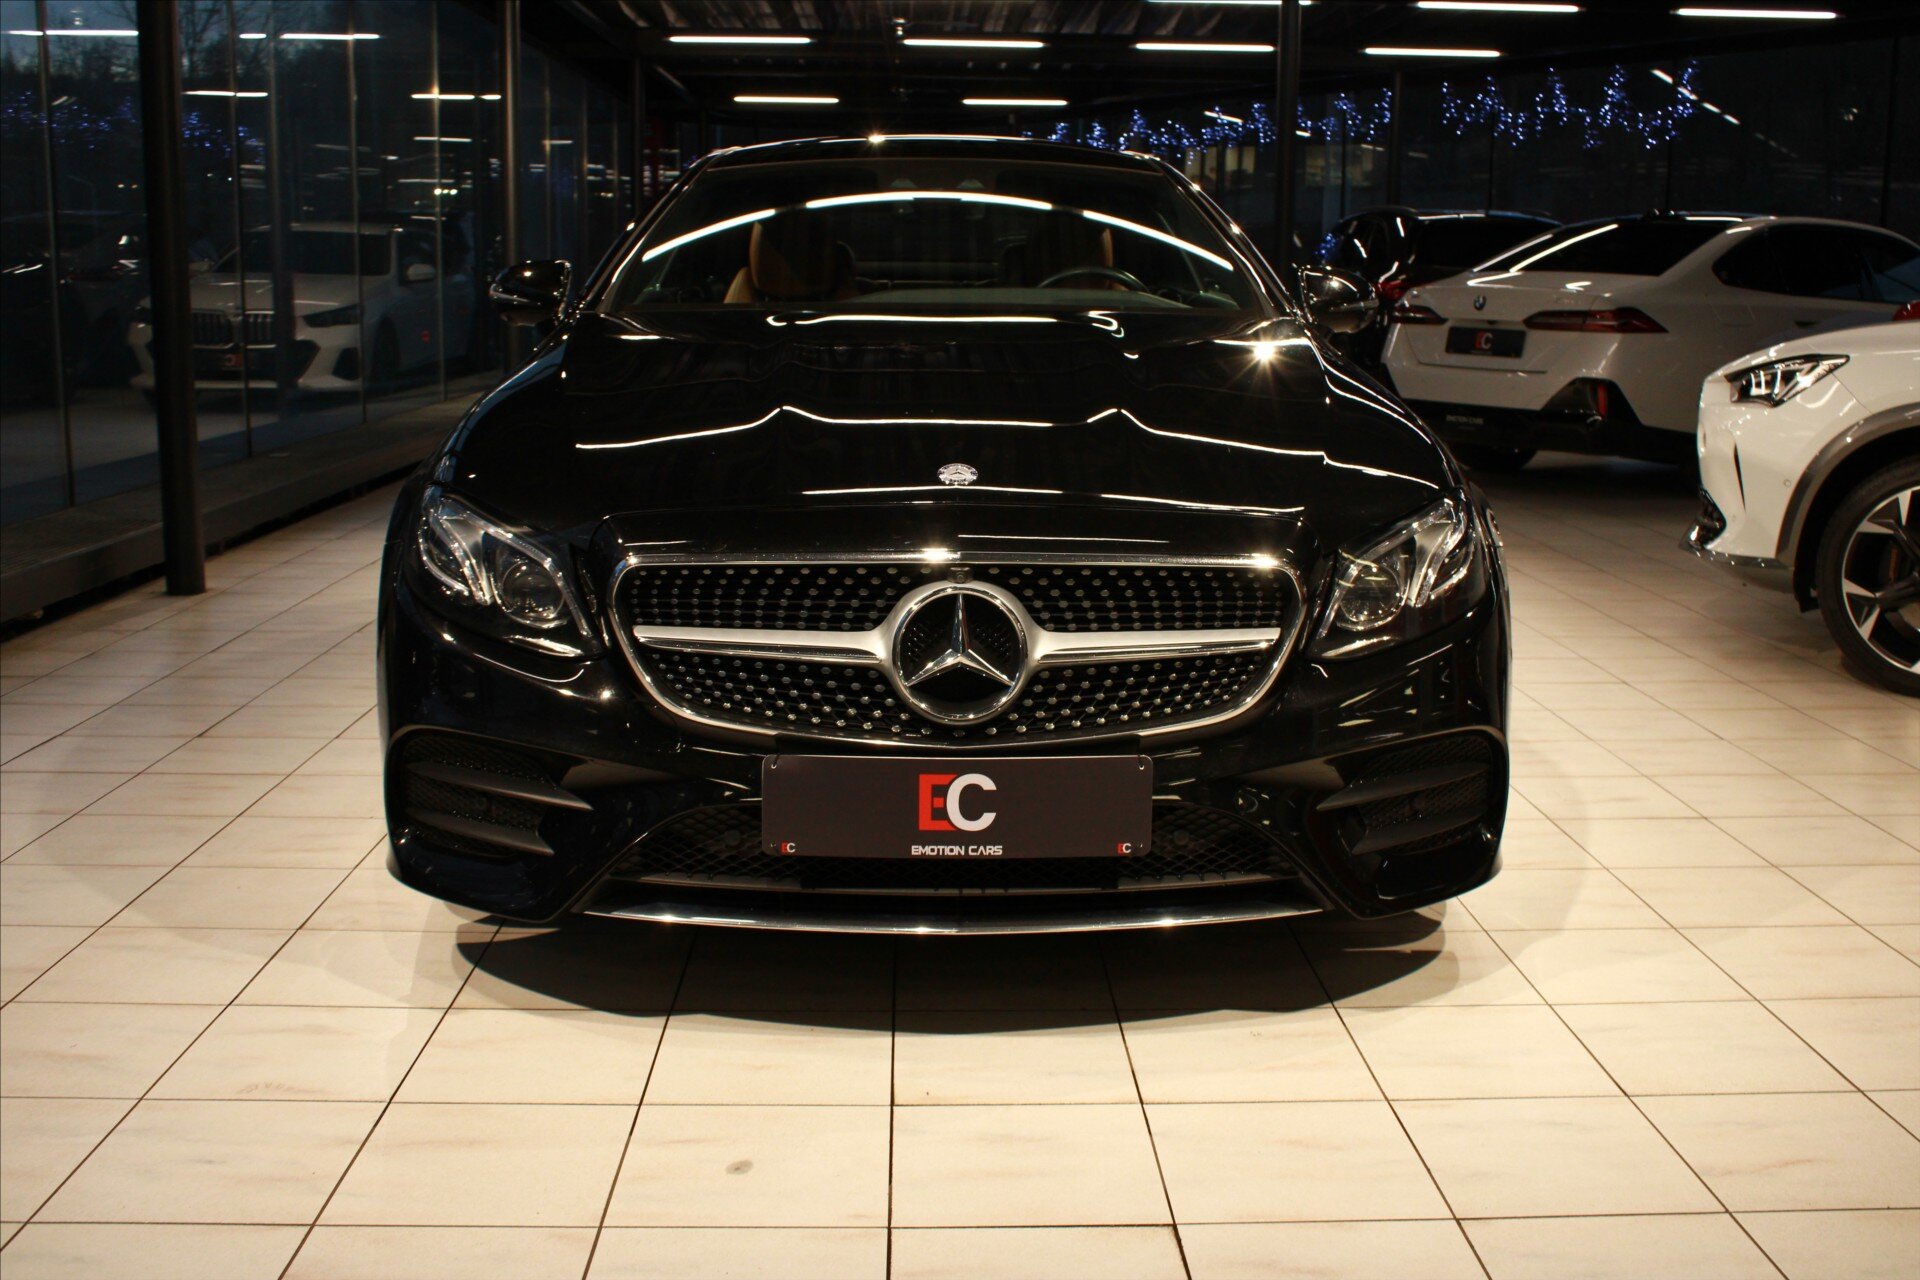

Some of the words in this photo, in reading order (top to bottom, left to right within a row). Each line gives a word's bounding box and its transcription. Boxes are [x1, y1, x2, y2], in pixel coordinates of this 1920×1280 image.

[918, 773, 997, 832] EC
[911, 845, 965, 856] EMOTION
[968, 845, 1003, 856] CARS
